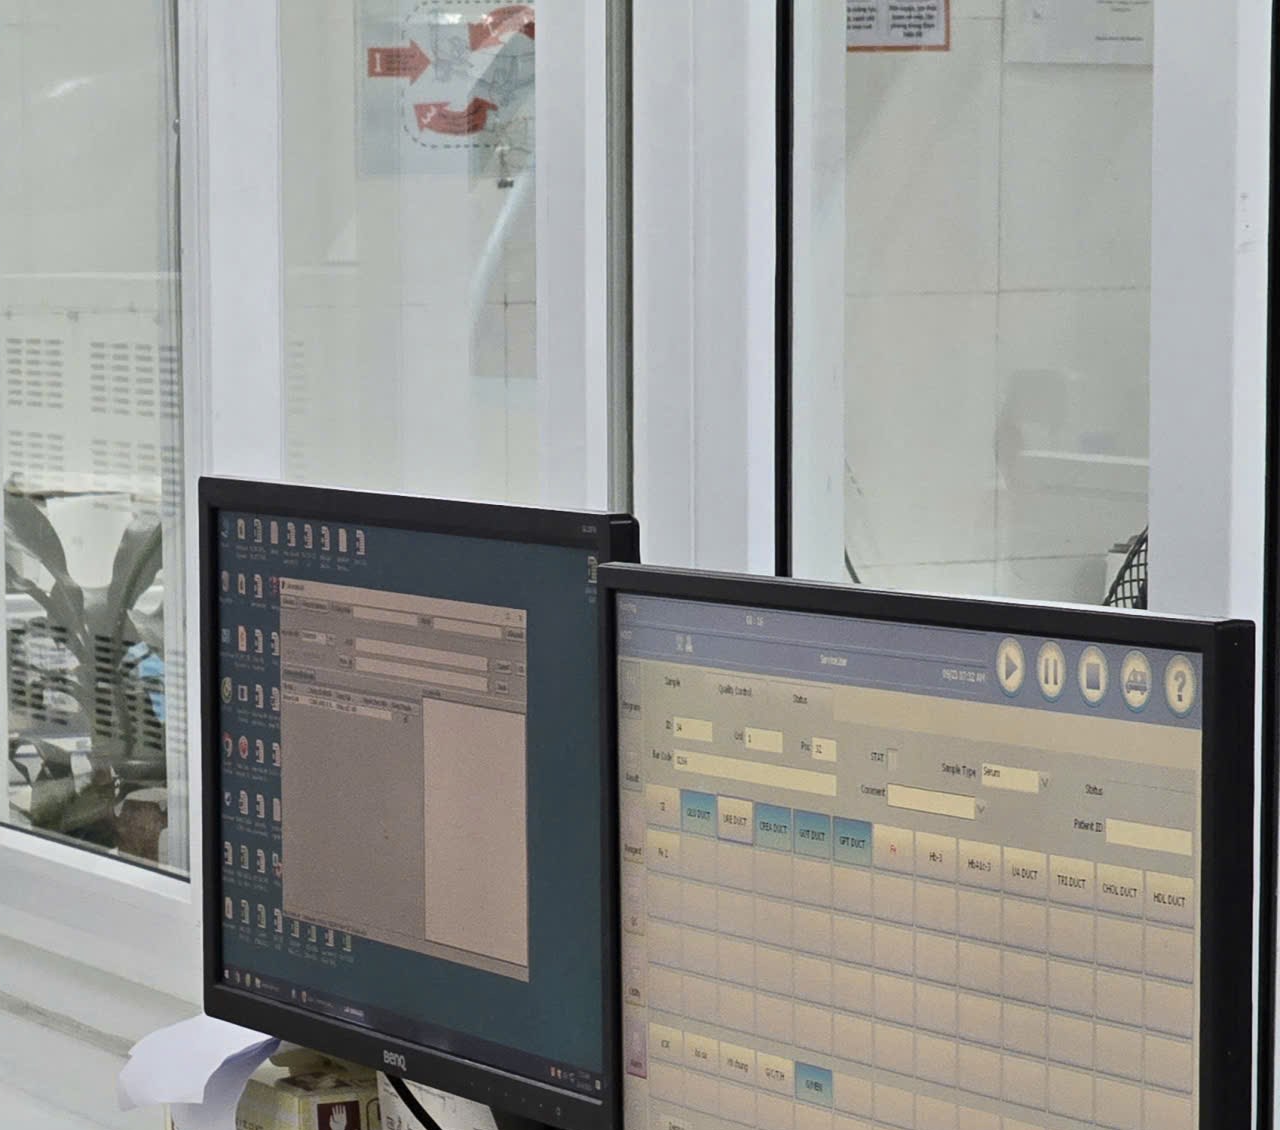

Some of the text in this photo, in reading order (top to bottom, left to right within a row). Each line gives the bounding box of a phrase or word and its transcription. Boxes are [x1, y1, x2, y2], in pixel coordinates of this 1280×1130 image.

[962, 765, 977, 778] Type
[734, 815, 748, 827] DUCT
[774, 824, 788, 835] DUCT
[811, 830, 826, 842] DUCT
[851, 838, 866, 850] DUCT
[1069, 877, 1087, 889] DUCT
[1120, 886, 1138, 898] DUCT
[1167, 896, 1186, 908] DUCT
